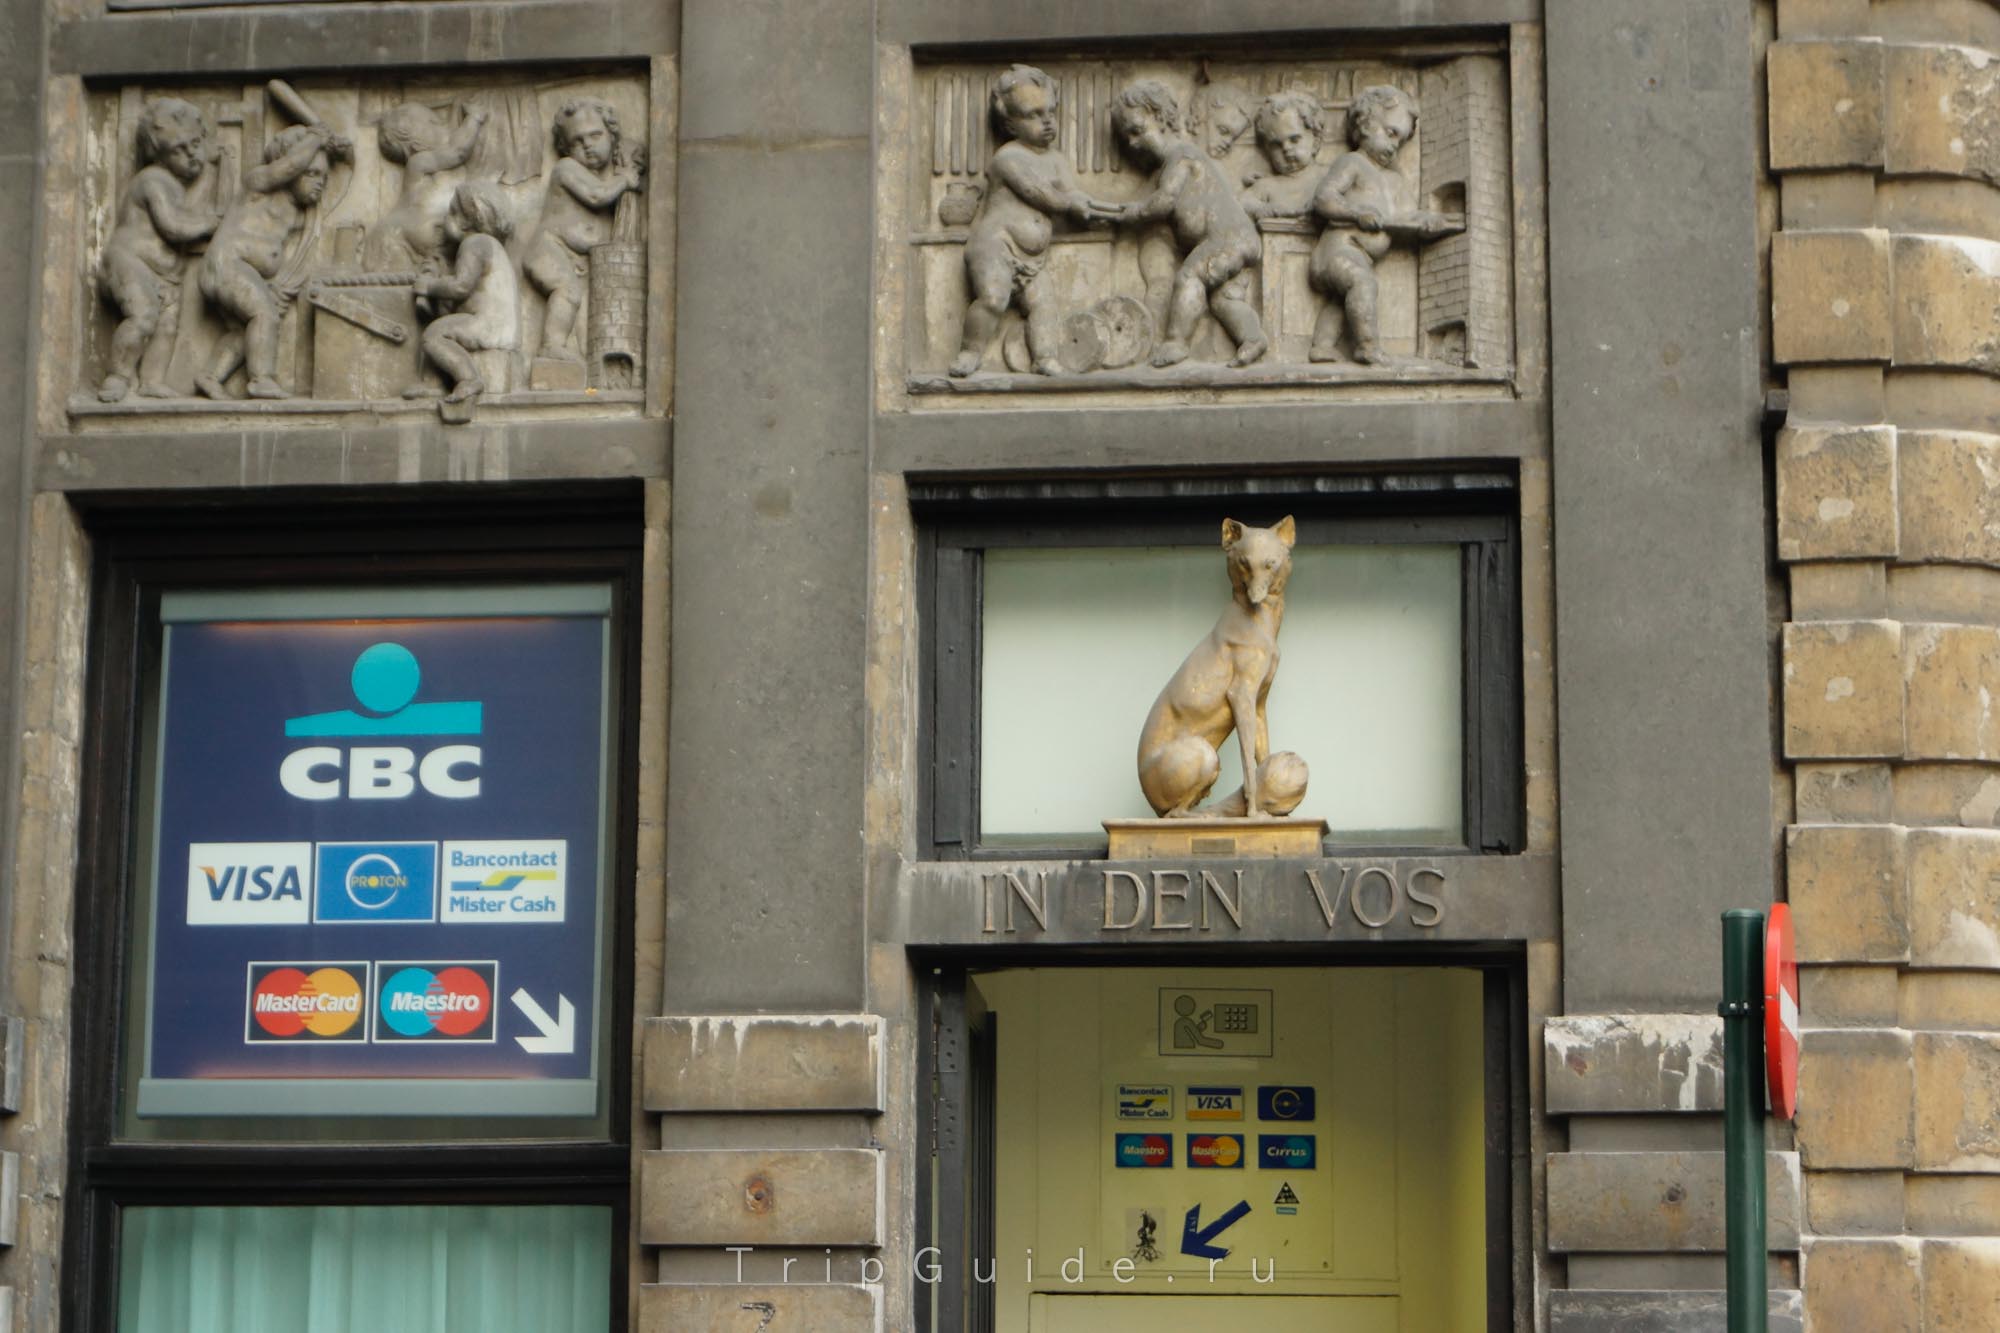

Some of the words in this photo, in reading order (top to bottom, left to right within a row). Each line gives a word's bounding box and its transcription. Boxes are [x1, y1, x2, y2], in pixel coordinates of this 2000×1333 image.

[279, 744, 483, 800] CBC
[450, 851, 558, 867] Bancontact
[198, 865, 302, 902] VISA
[351, 875, 408, 888] PROTON
[449, 896, 505, 914] Mister
[509, 896, 556, 913] Cash
[981, 872, 1049, 933] IN
[1102, 870, 1246, 931] DEN
[1304, 866, 1446, 929] VOS
[255, 992, 360, 1013] MasterCard
[390, 992, 481, 1012] Maestro
[1119, 1087, 1169, 1096] Bancontact
[1197, 1097, 1233, 1110] VISA
[1147, 1109, 1169, 1117] Cash
[1124, 1145, 1165, 1155] Maestro
[1266, 1147, 1307, 1157] Cirrus
